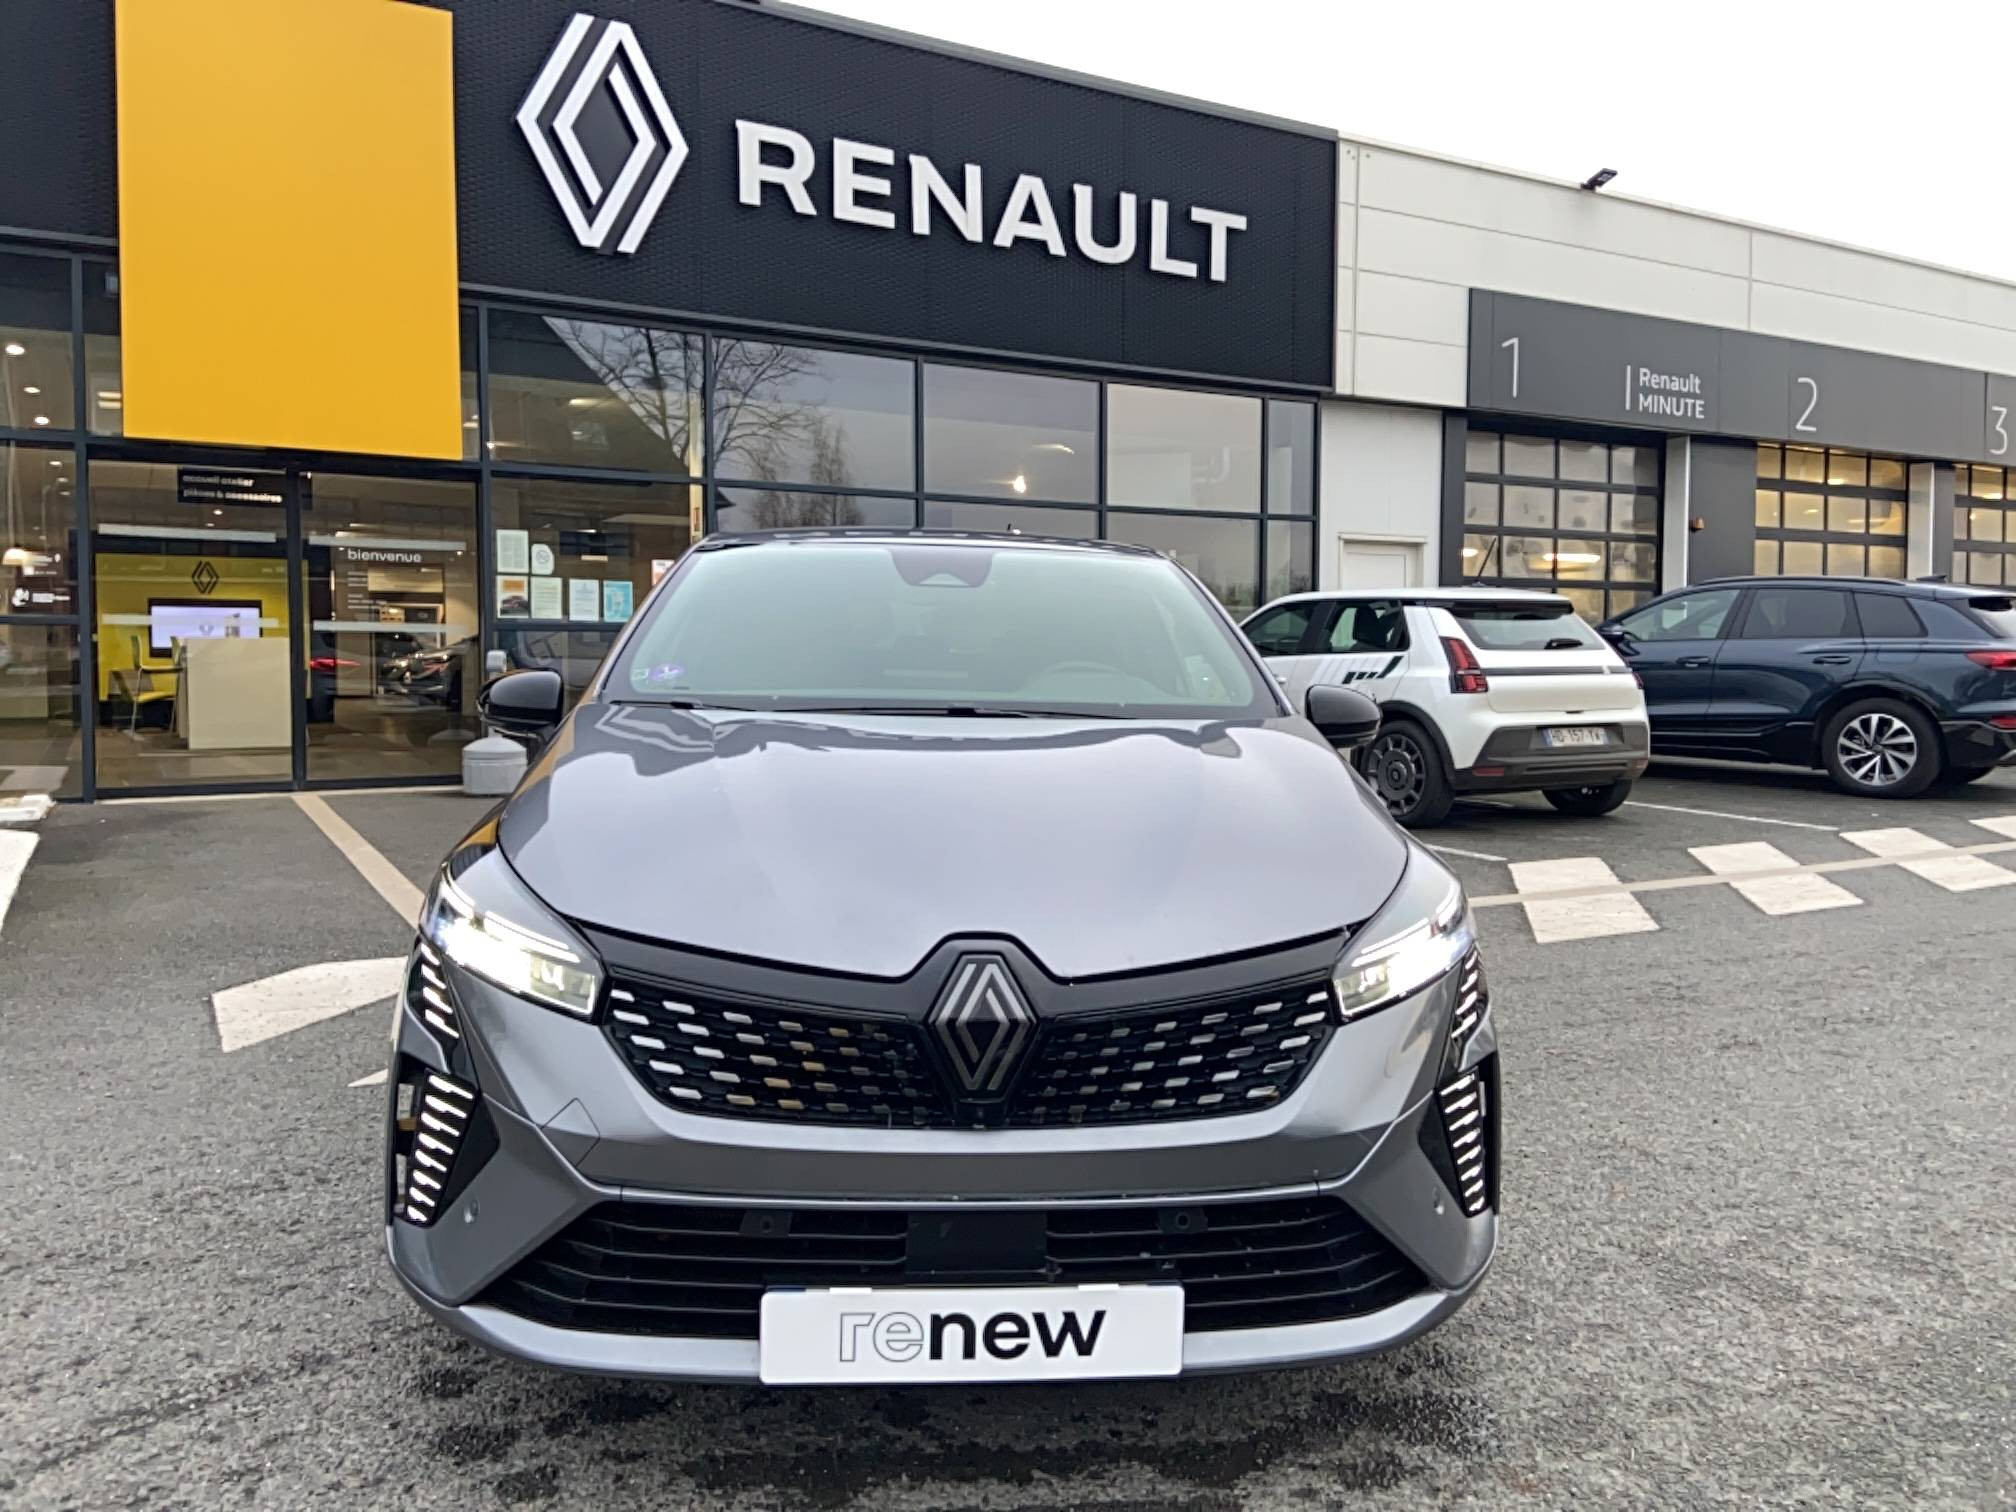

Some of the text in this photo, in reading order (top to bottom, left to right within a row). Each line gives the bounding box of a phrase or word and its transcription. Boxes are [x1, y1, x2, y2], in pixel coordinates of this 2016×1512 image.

[736, 119, 1247, 282] RENAULT
[1502, 337, 1519, 398] 1
[1639, 367, 1701, 394] Renault
[1639, 393, 1704, 419] MINUTE
[1796, 377, 1817, 431] 2
[1990, 405, 2007, 455] 3
[347, 547, 422, 563] bienvenue
[839, 1309, 1107, 1363] renew
